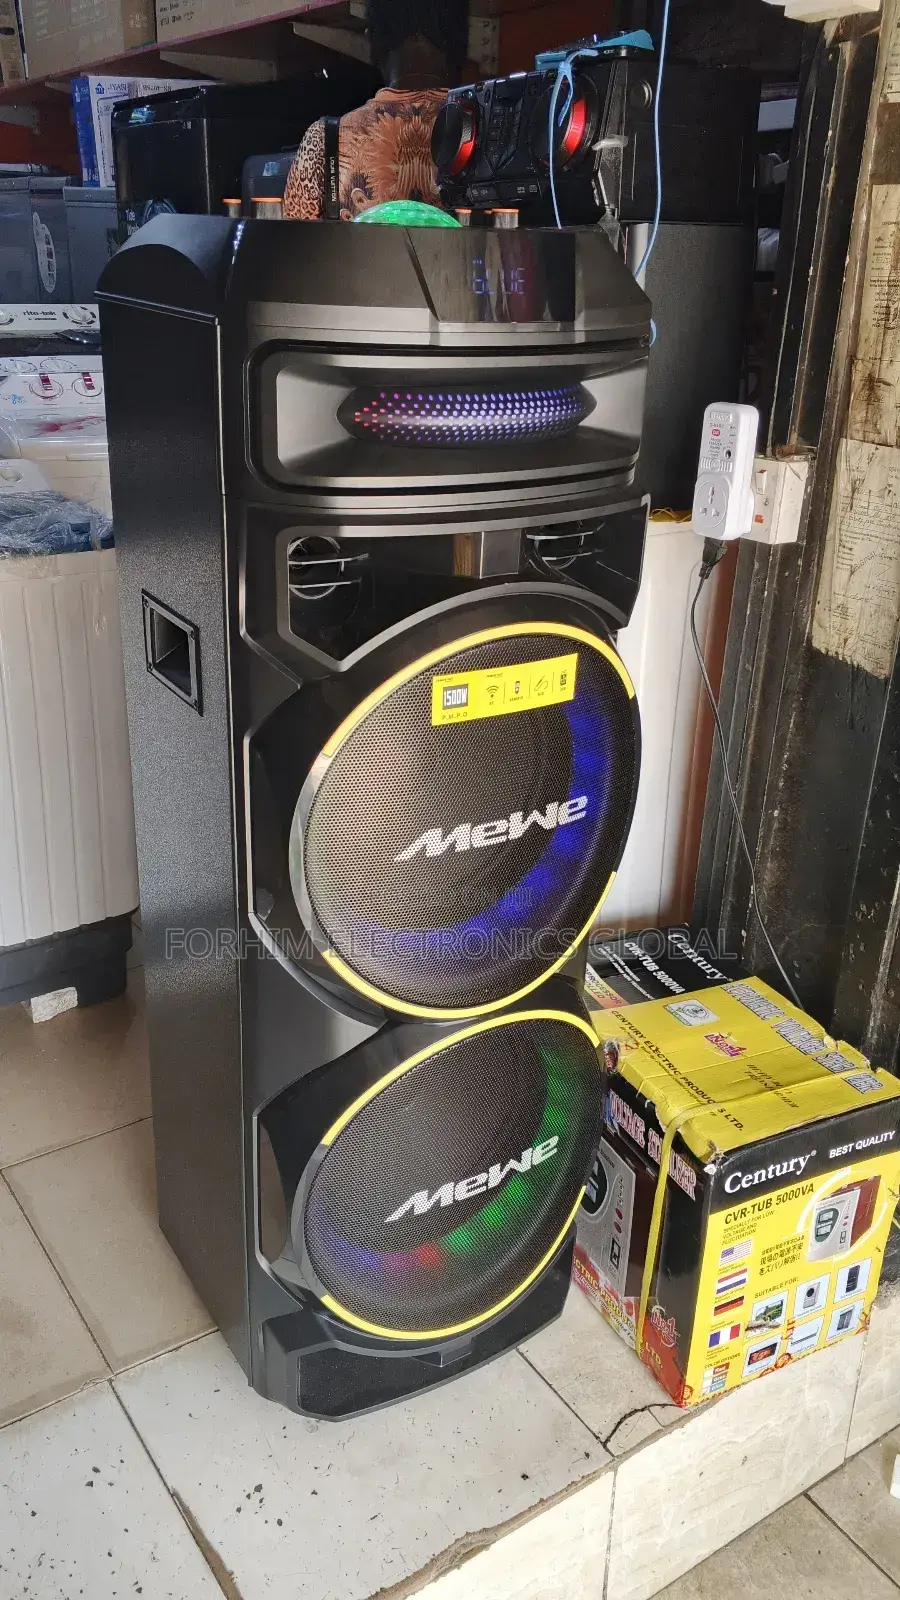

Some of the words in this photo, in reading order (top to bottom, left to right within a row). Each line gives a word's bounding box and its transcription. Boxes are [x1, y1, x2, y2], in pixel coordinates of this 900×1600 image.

[443, 687, 468, 707] 1500W
[624, 941, 660, 972] CVR-TUB
[653, 967, 686, 994] 5000VA
[668, 933, 728, 980] Century
[586, 968, 622, 1004] PROCESSOR
[611, 1010, 647, 1039] CENTURY
[644, 1040, 682, 1076] ELECTRIC
[680, 1076, 727, 1114] PRODUCS
[724, 1114, 744, 1131] LTD.
[724, 1154, 811, 1194] Century
[829, 1142, 855, 1159] BEST
[855, 1130, 896, 1151] QUALITY
[724, 1198, 773, 1225] CVR-TUB
[776, 1182, 815, 1205] 5000VA
[754, 1281, 784, 1299] SUITABLE
